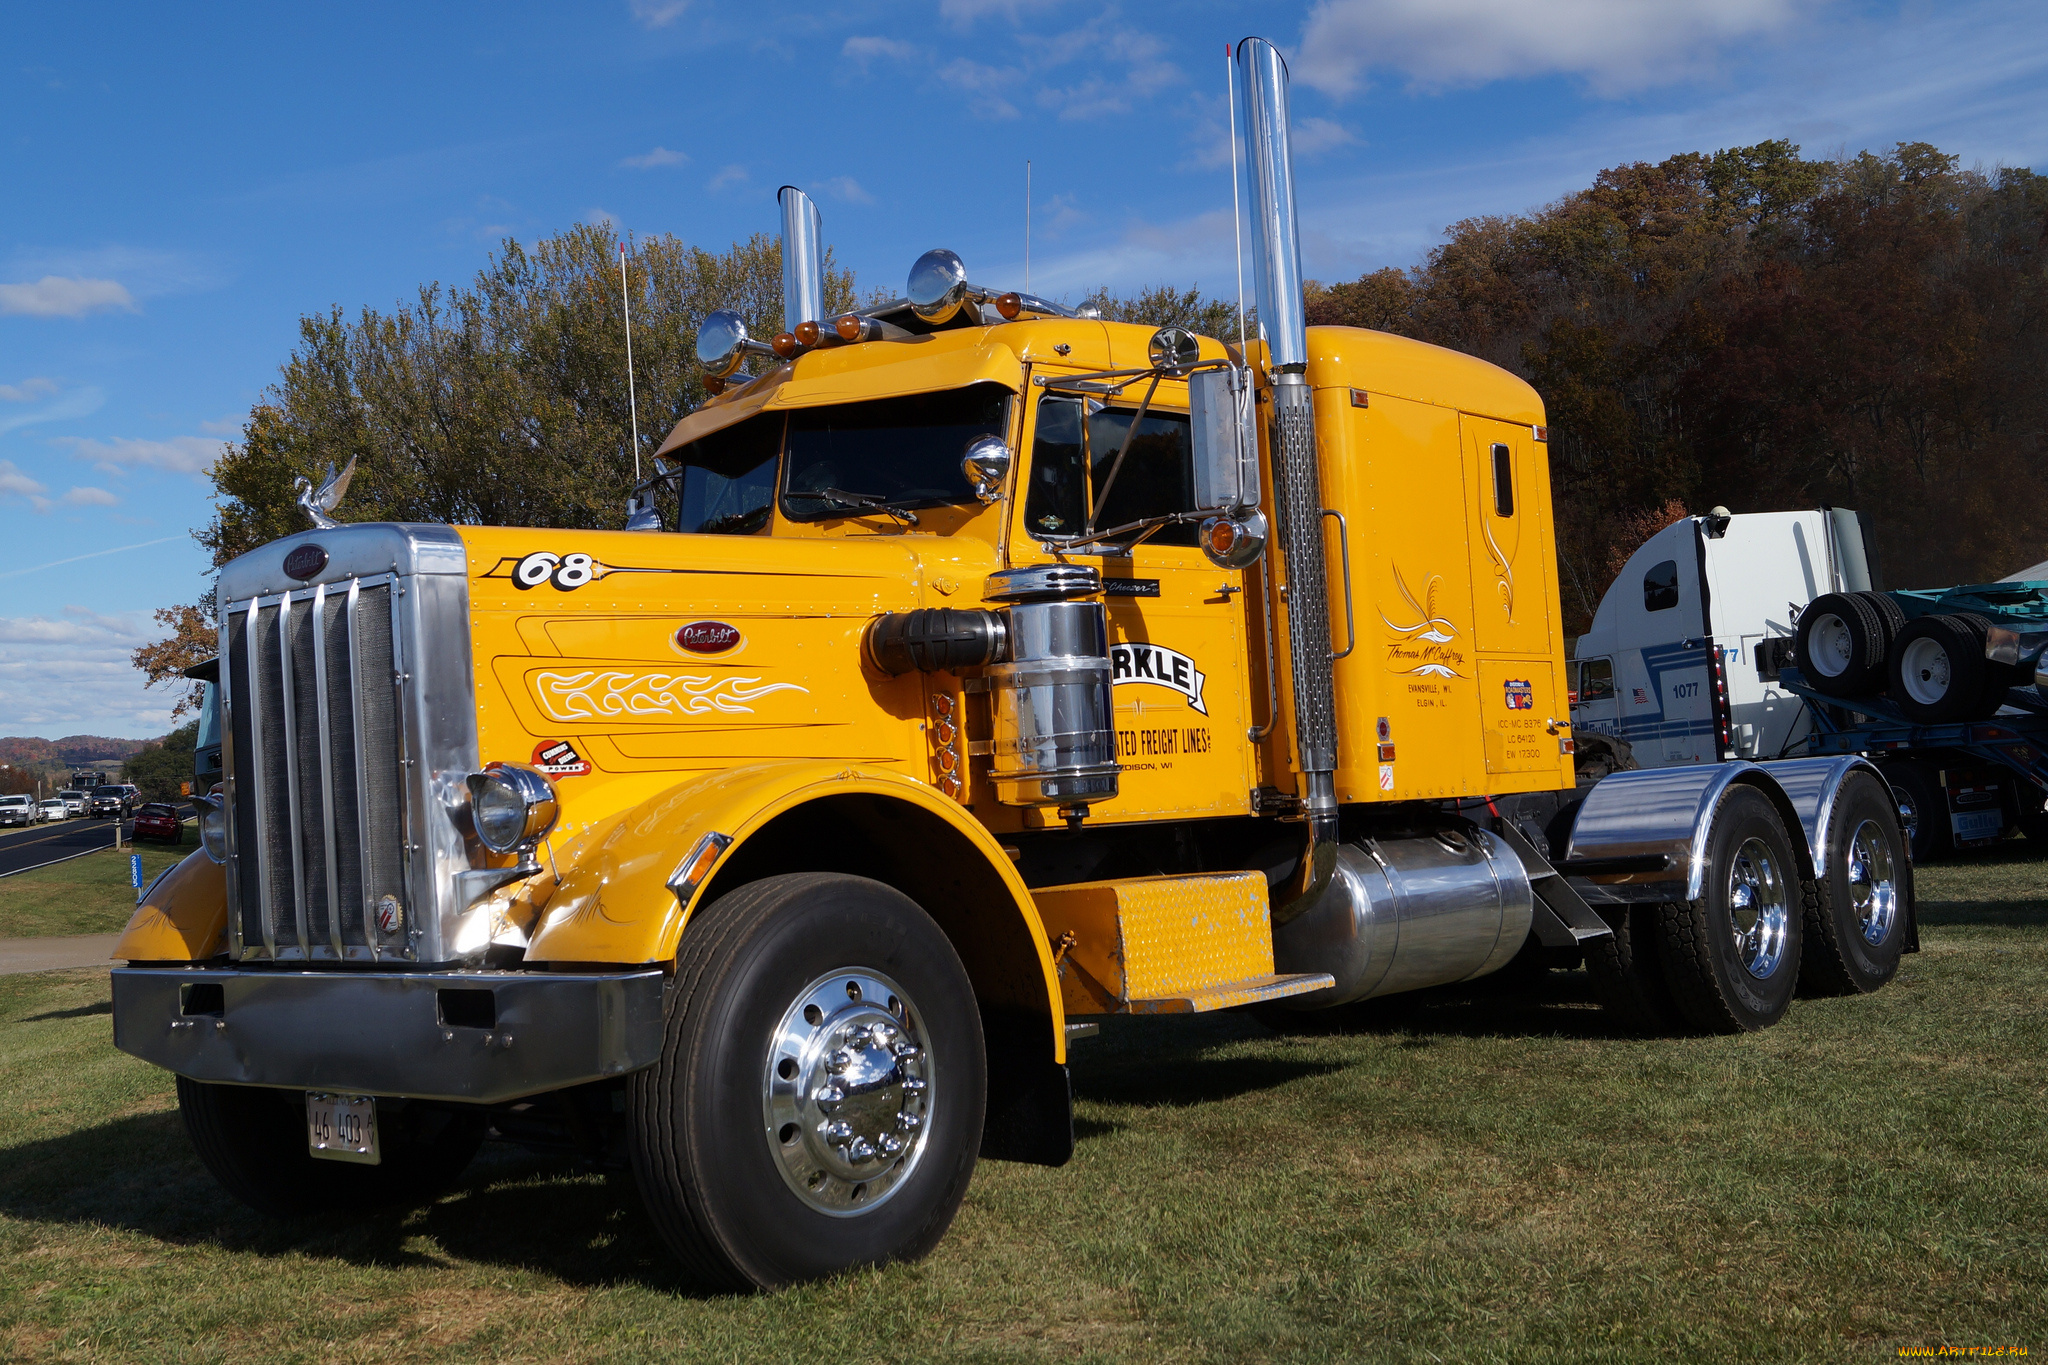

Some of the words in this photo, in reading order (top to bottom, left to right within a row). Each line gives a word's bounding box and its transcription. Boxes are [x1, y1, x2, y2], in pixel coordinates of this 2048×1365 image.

[514, 551, 593, 590] 68
[684, 627, 736, 646] Peterbilt
[1387, 643, 1420, 661] Thomas
[1420, 645, 1466, 667] McCaffrey
[1408, 684, 1440, 695] EVANSVILLE,
[1673, 682, 1699, 699] 1077
[1497, 719, 1522, 729] ICC-MC
[1524, 719, 1541, 729] 8376
[1141, 729, 1178, 756] FREIGHT
[1182, 727, 1207, 754] LINES
[1507, 735, 1516, 744] LC
[1517, 734, 1536, 744] 64120
[1506, 750, 1516, 759] EW
[1518, 749, 1540, 759] 17300
[315, 1111, 330, 1141] 46
[339, 1113, 361, 1143] 403
